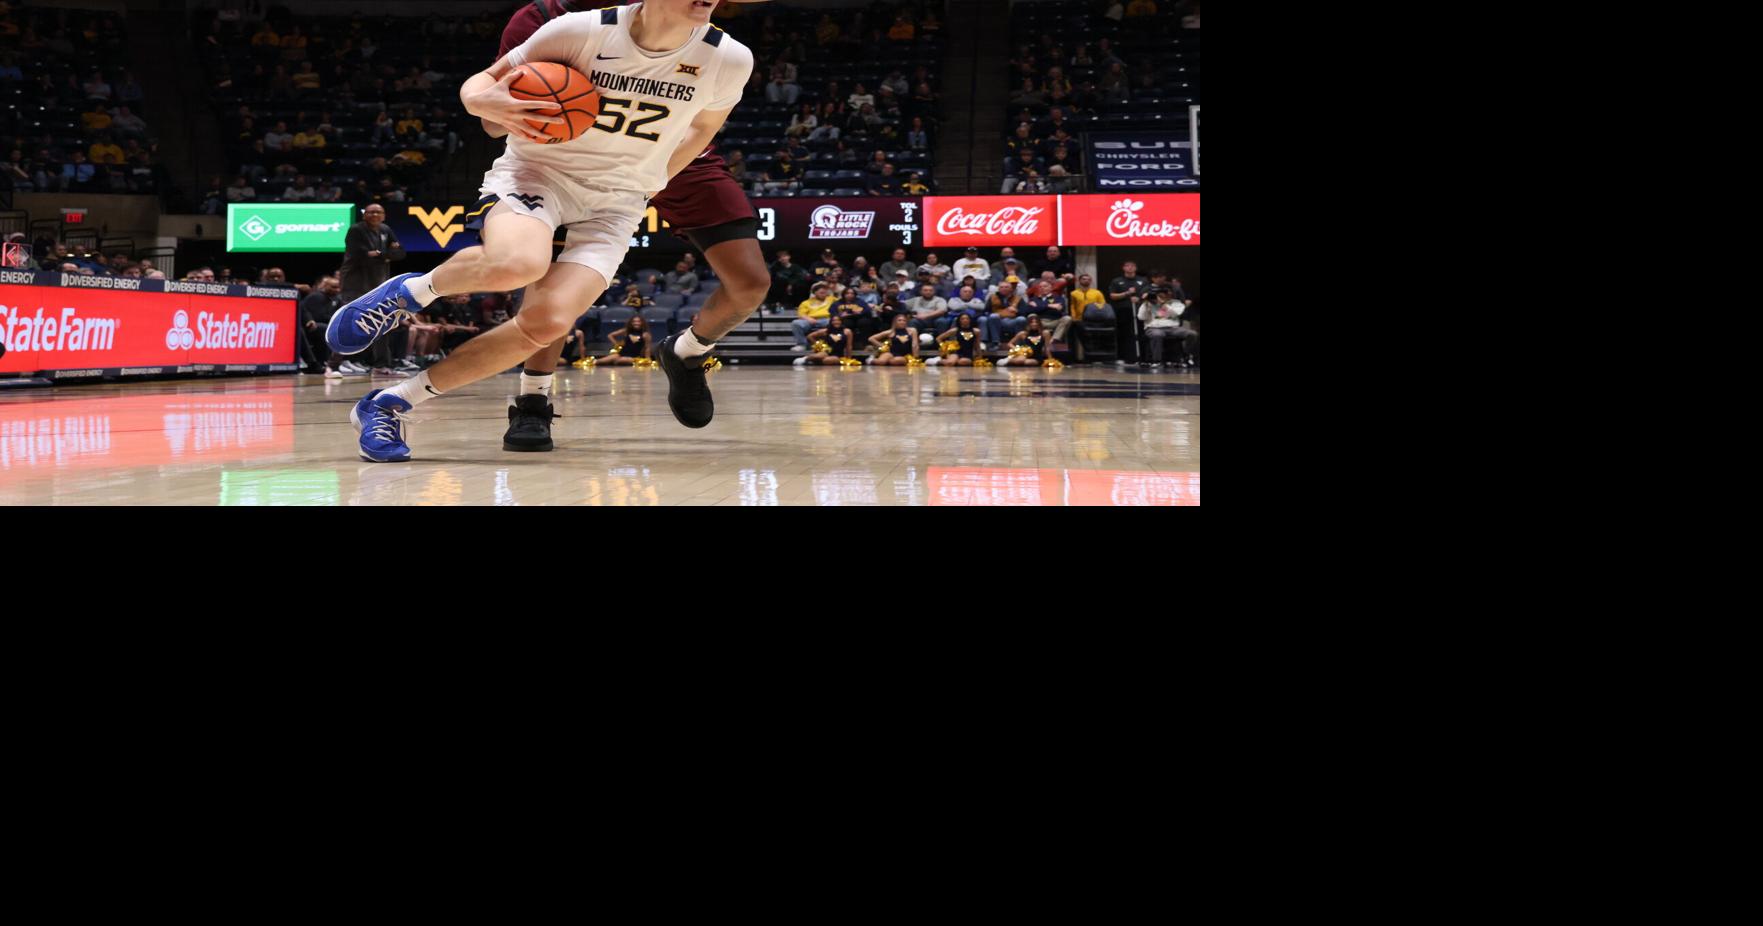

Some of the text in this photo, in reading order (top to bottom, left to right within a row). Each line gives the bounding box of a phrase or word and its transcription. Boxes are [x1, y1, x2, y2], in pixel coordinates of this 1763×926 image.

[590, 70, 696, 102] MOUNTAINEERS
[592, 96, 671, 142] 52
[838, 214, 872, 222] LITTLE
[904, 209, 913, 223] 2
[936, 206, 1044, 235] Coca-Cola
[275, 222, 341, 234] gomart
[836, 221, 869, 229] ROCK
[902, 231, 912, 245] 3
[0, 271, 35, 284] ENERGY
[69, 274, 141, 290] DIVERSIFIED ENERGY
[195, 310, 276, 349] StateFarm
